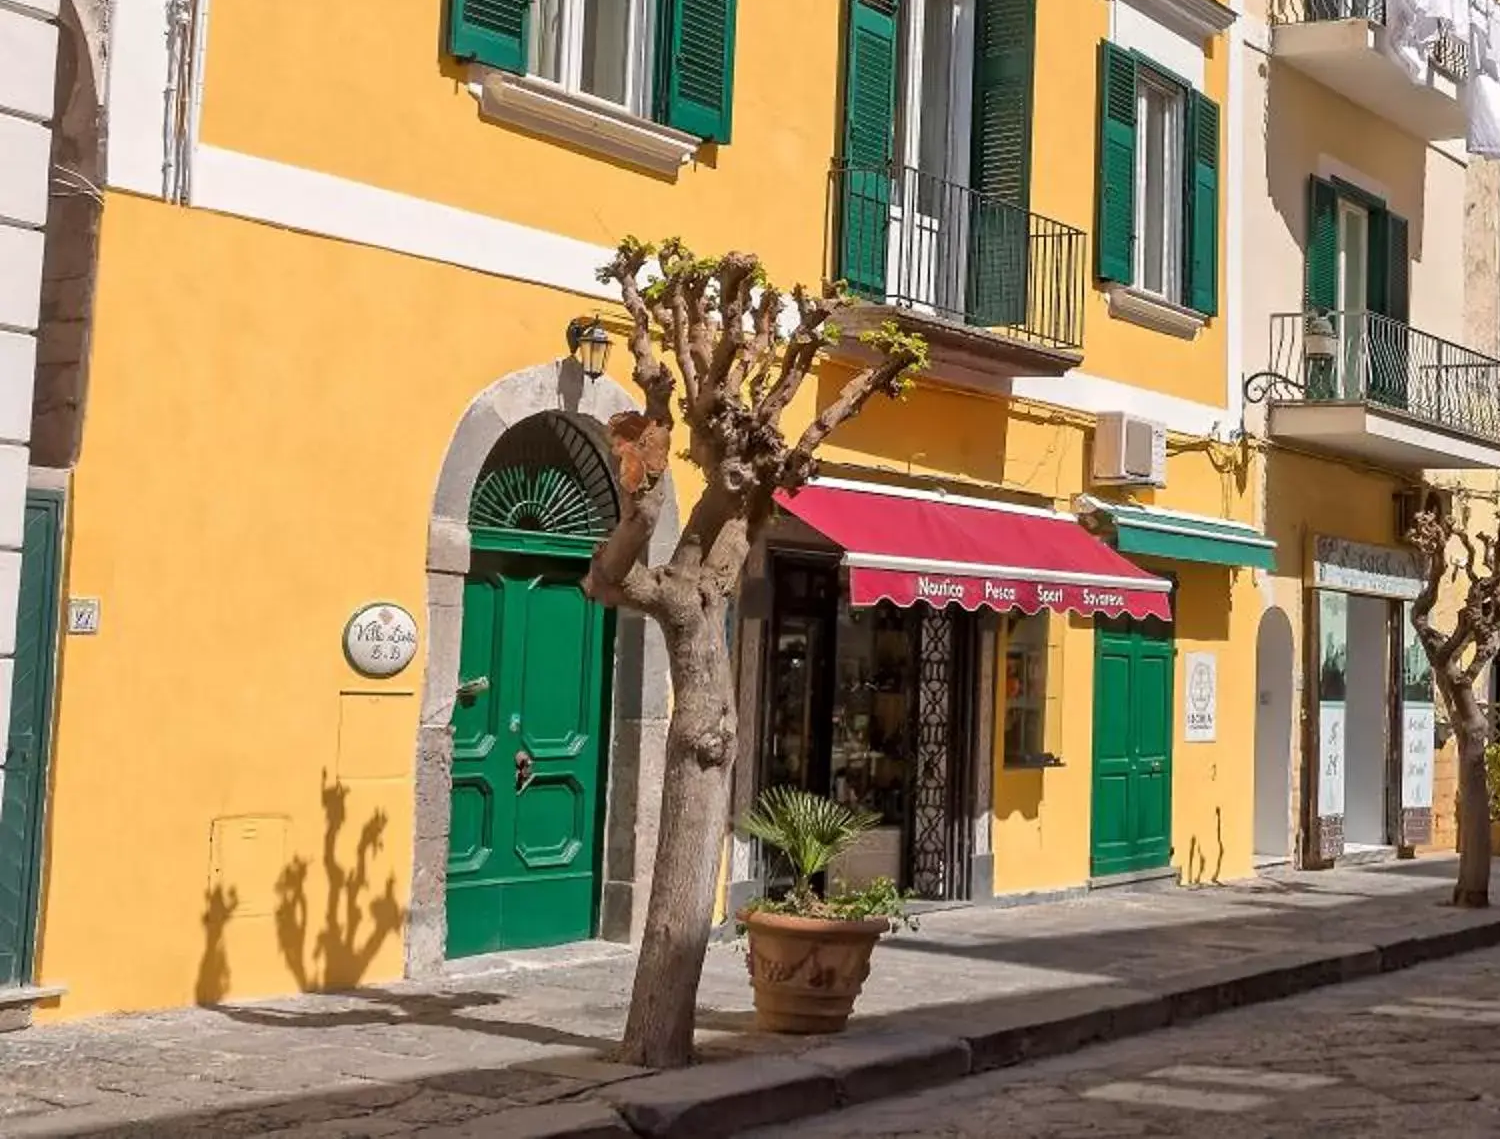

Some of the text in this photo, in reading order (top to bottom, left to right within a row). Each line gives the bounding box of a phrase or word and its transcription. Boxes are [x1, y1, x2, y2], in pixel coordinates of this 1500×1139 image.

[918, 577, 1124, 606] Nautica Pesca Sport Savarese
